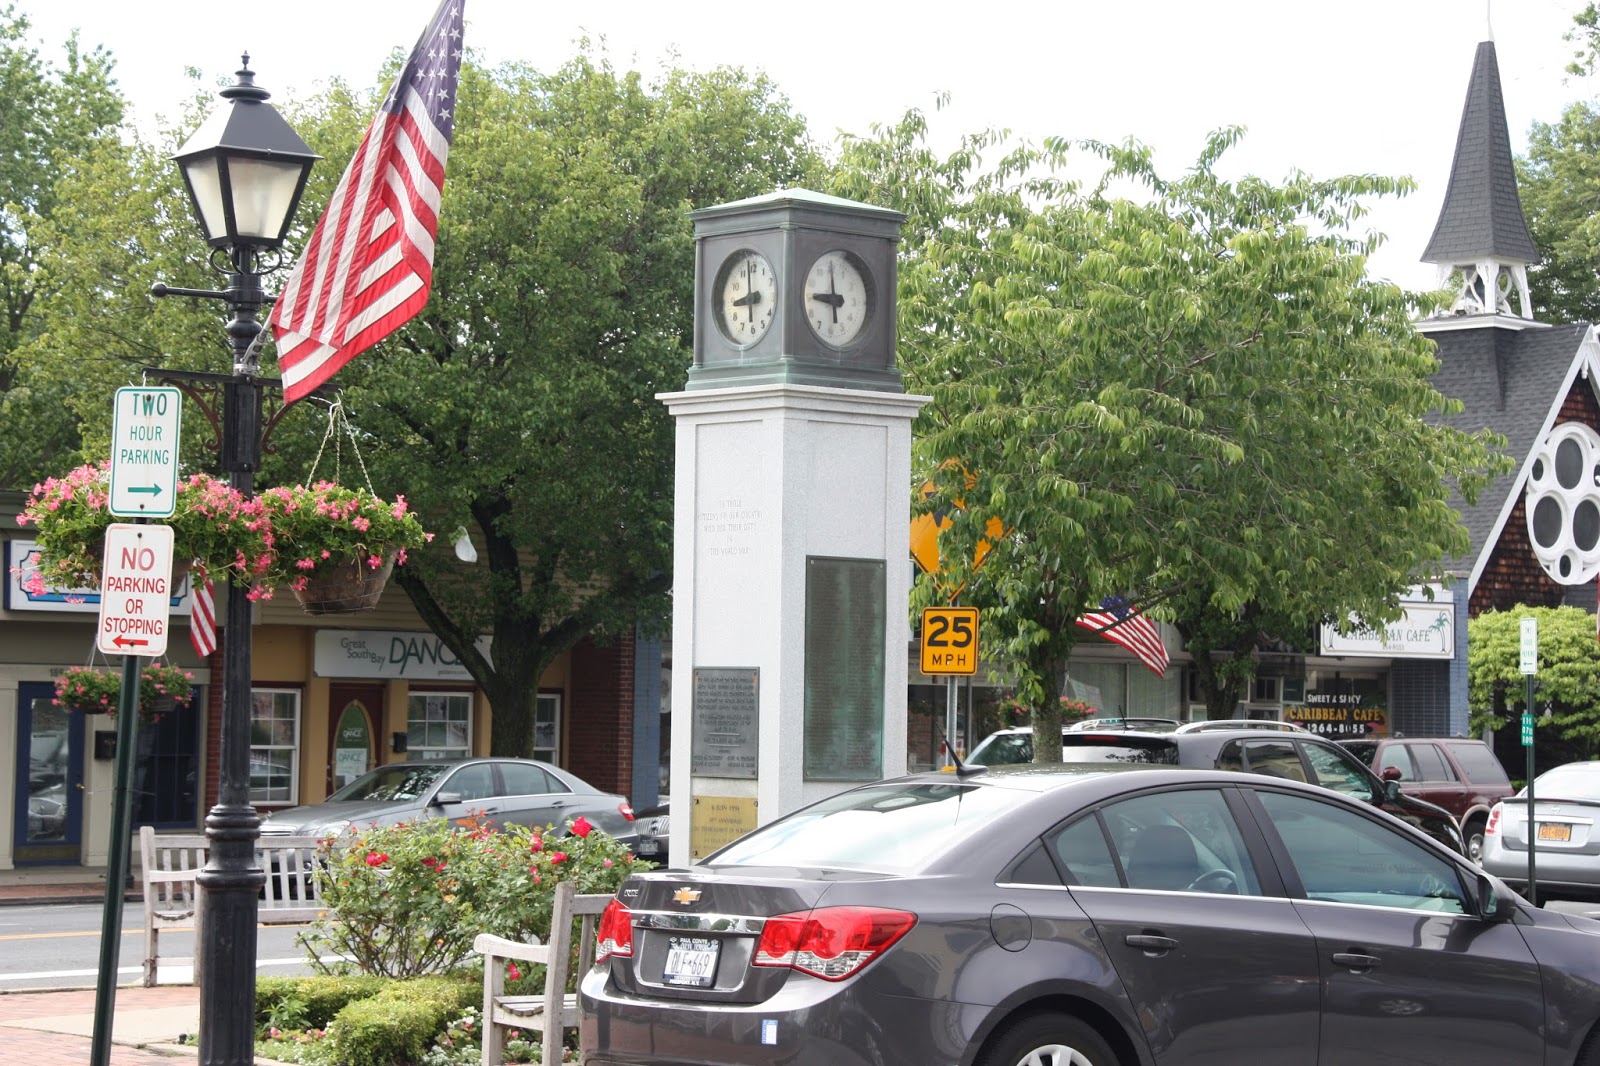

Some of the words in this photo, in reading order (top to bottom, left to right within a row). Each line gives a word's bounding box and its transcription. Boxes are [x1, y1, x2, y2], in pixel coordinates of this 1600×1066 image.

[133, 393, 167, 416] TWO
[130, 425, 163, 441] HOUR
[120, 449, 169, 465] PARKING
[121, 547, 155, 571] NO
[107, 577, 165, 594] PARKING
[125, 598, 143, 614] OR
[104, 617, 163, 636] STOPPING
[927, 615, 972, 648] 25
[340, 637, 366, 649] Great
[1406, 629, 1431, 642] CAFE
[347, 648, 371, 659] South
[371, 653, 386, 671] Bay
[389, 637, 465, 675] DANC
[932, 654, 966, 666] MPH
[1307, 694, 1331, 703] SWEET
[1289, 707, 1349, 720] CARIBBEAN
[1353, 708, 1381, 721] CAFE
